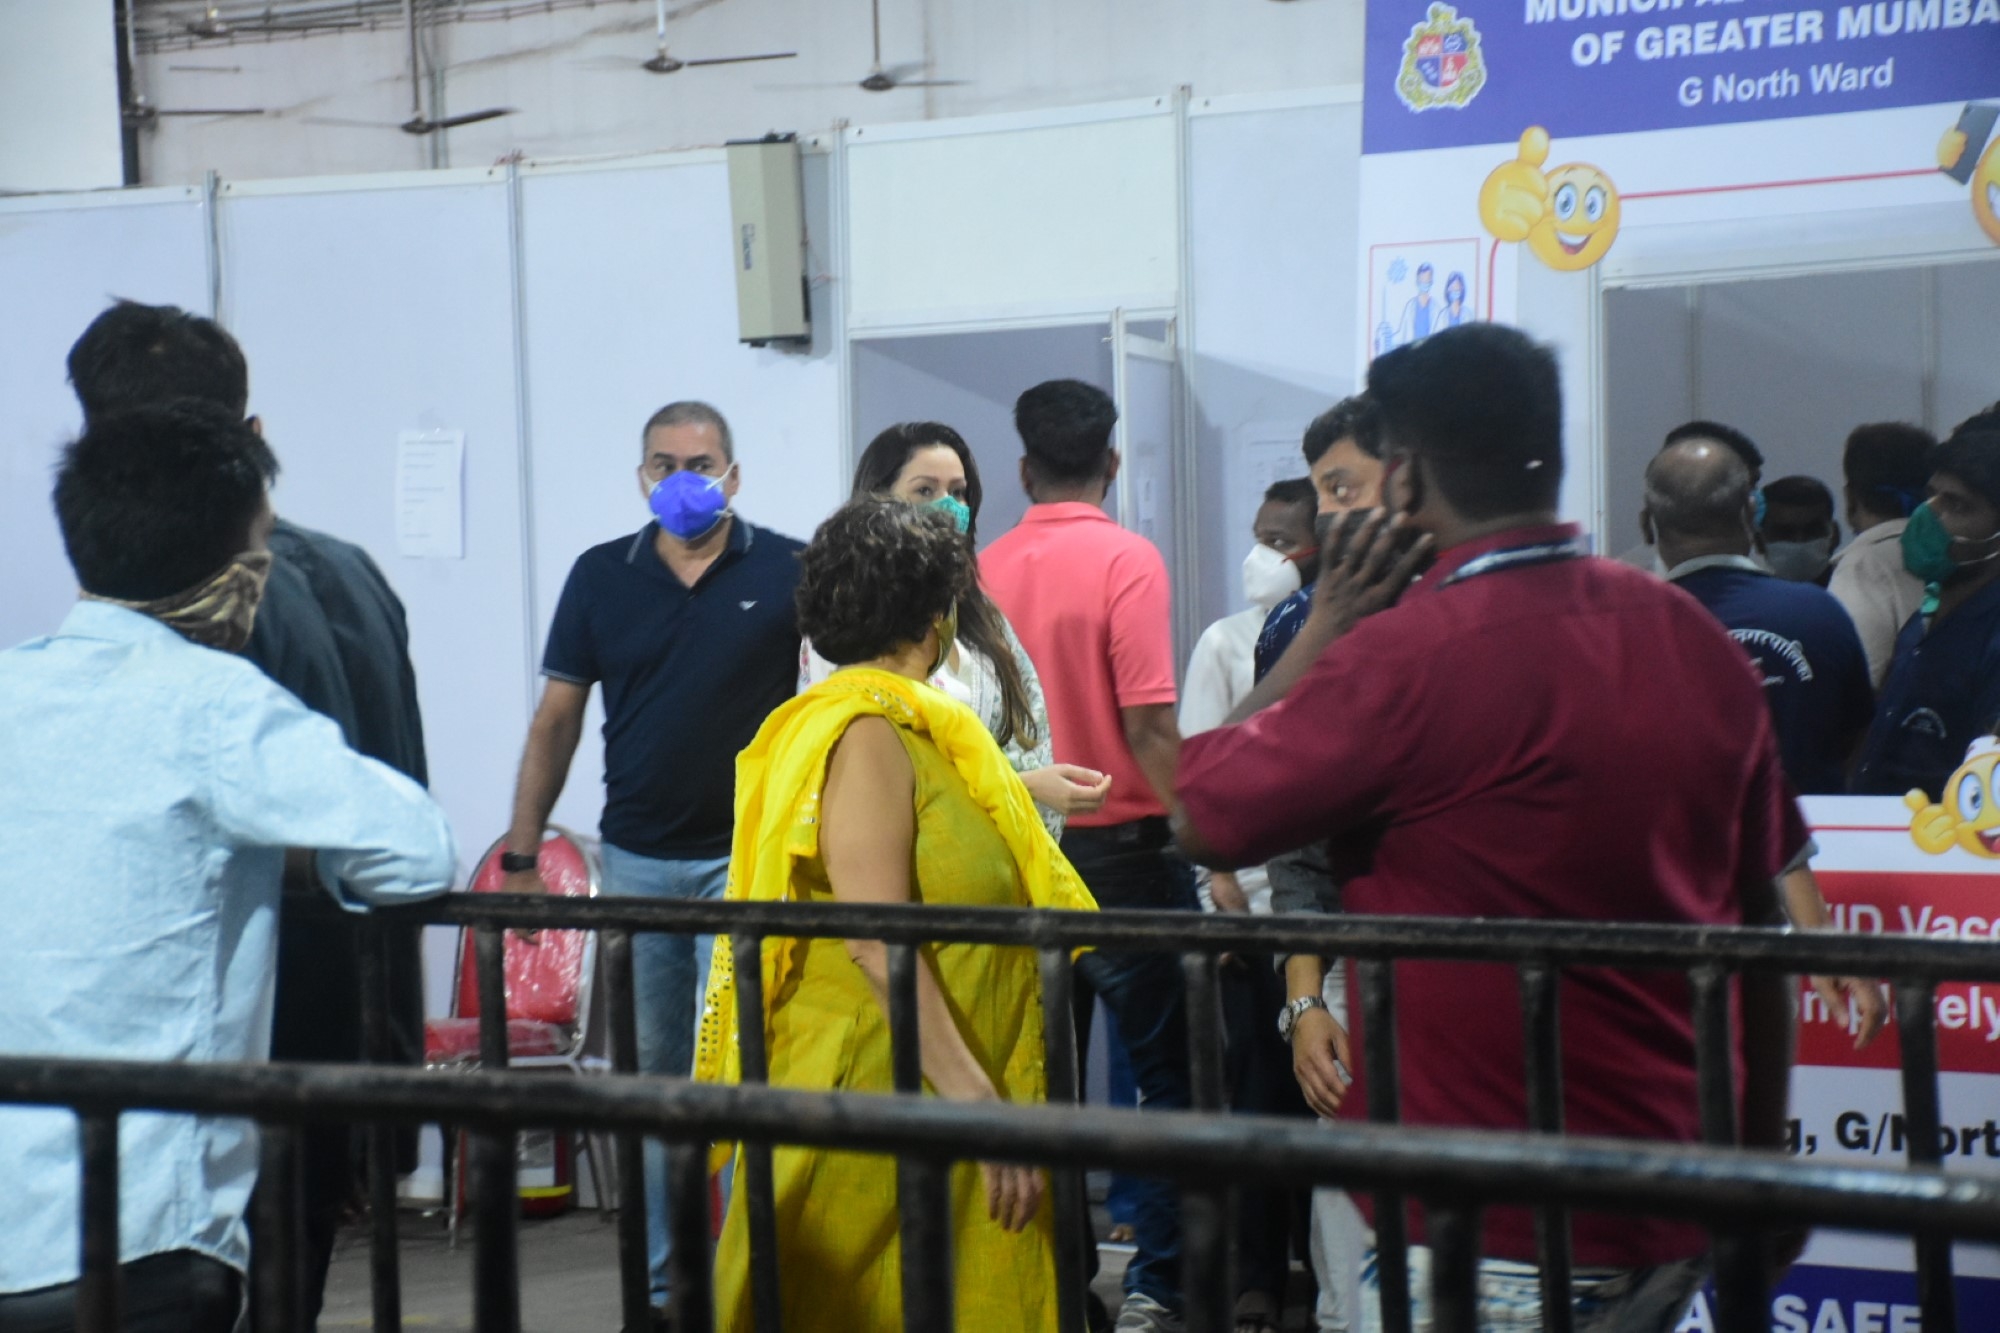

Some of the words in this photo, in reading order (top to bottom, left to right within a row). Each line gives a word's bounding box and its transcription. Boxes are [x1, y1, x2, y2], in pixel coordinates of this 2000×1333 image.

[1571, 31, 1625, 67] OF
[1634, 10, 1824, 61] GREATER
[1678, 76, 1704, 107] G
[1712, 68, 1800, 104] North
[1809, 57, 1895, 95] Ward
